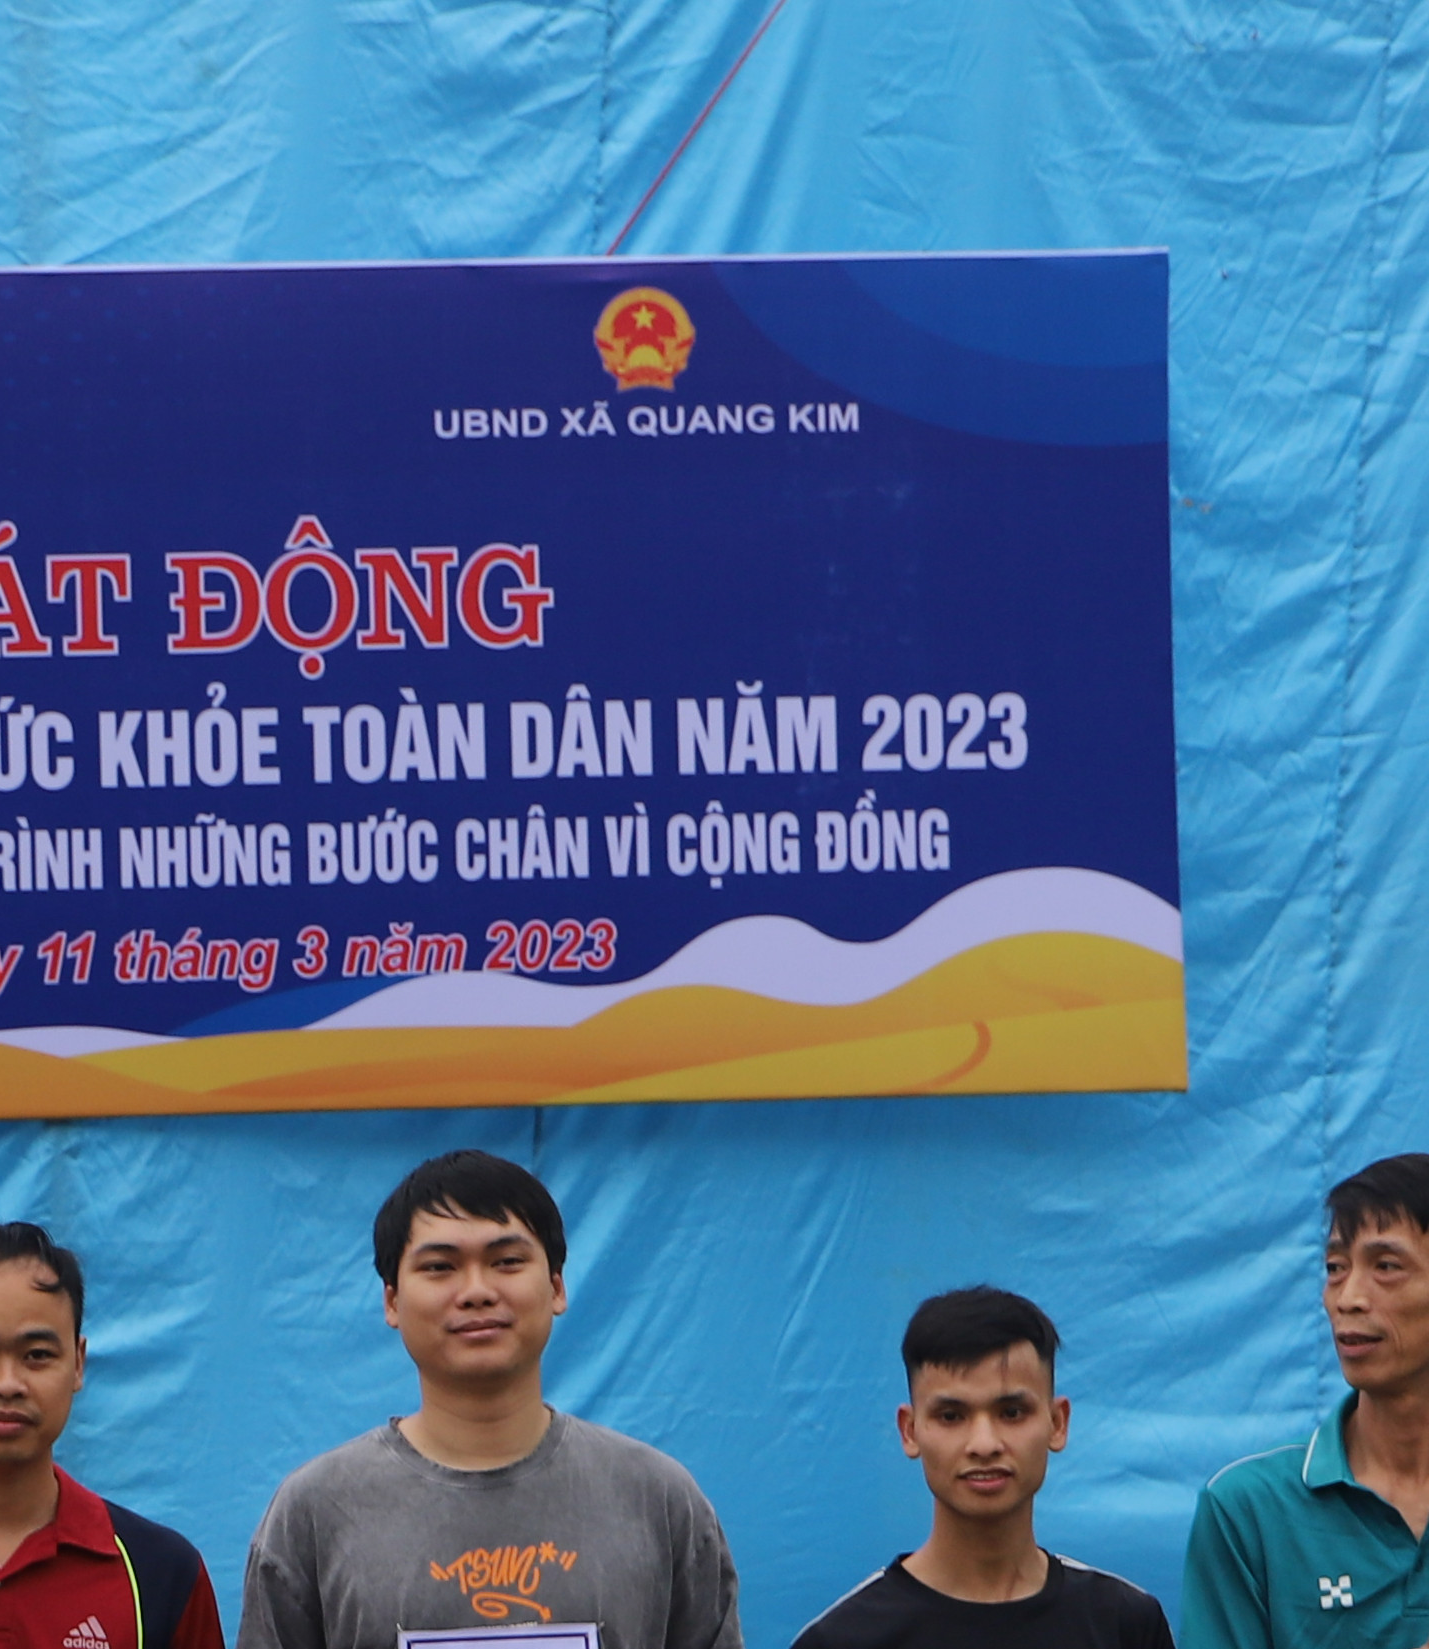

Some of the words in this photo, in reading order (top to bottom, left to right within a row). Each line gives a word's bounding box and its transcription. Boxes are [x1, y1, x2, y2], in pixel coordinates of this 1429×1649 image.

[435, 409, 547, 438] UBND
[561, 401, 615, 435] XÃ
[628, 404, 774, 436] QUANG
[789, 403, 858, 432] KIM
[165, 515, 554, 682] ĐỘNG
[99, 685, 280, 787] KHỎE
[303, 688, 485, 782] TOÀN
[511, 684, 652, 778] DÂN
[677, 681, 837, 774] NĂM
[862, 692, 1027, 771] 2023
[120, 814, 291, 888] NHỮNG
[308, 808, 438, 883] BƯỚC
[456, 805, 589, 880] CHÂN
[604, 803, 649, 876] VÌ
[667, 801, 800, 887] CỘNG
[815, 789, 949, 872] ĐỒNG
[37, 931, 95, 984] 11
[114, 927, 279, 989] tháng
[293, 925, 329, 978] 3
[342, 927, 467, 976] năm
[486, 918, 617, 973] 2023
